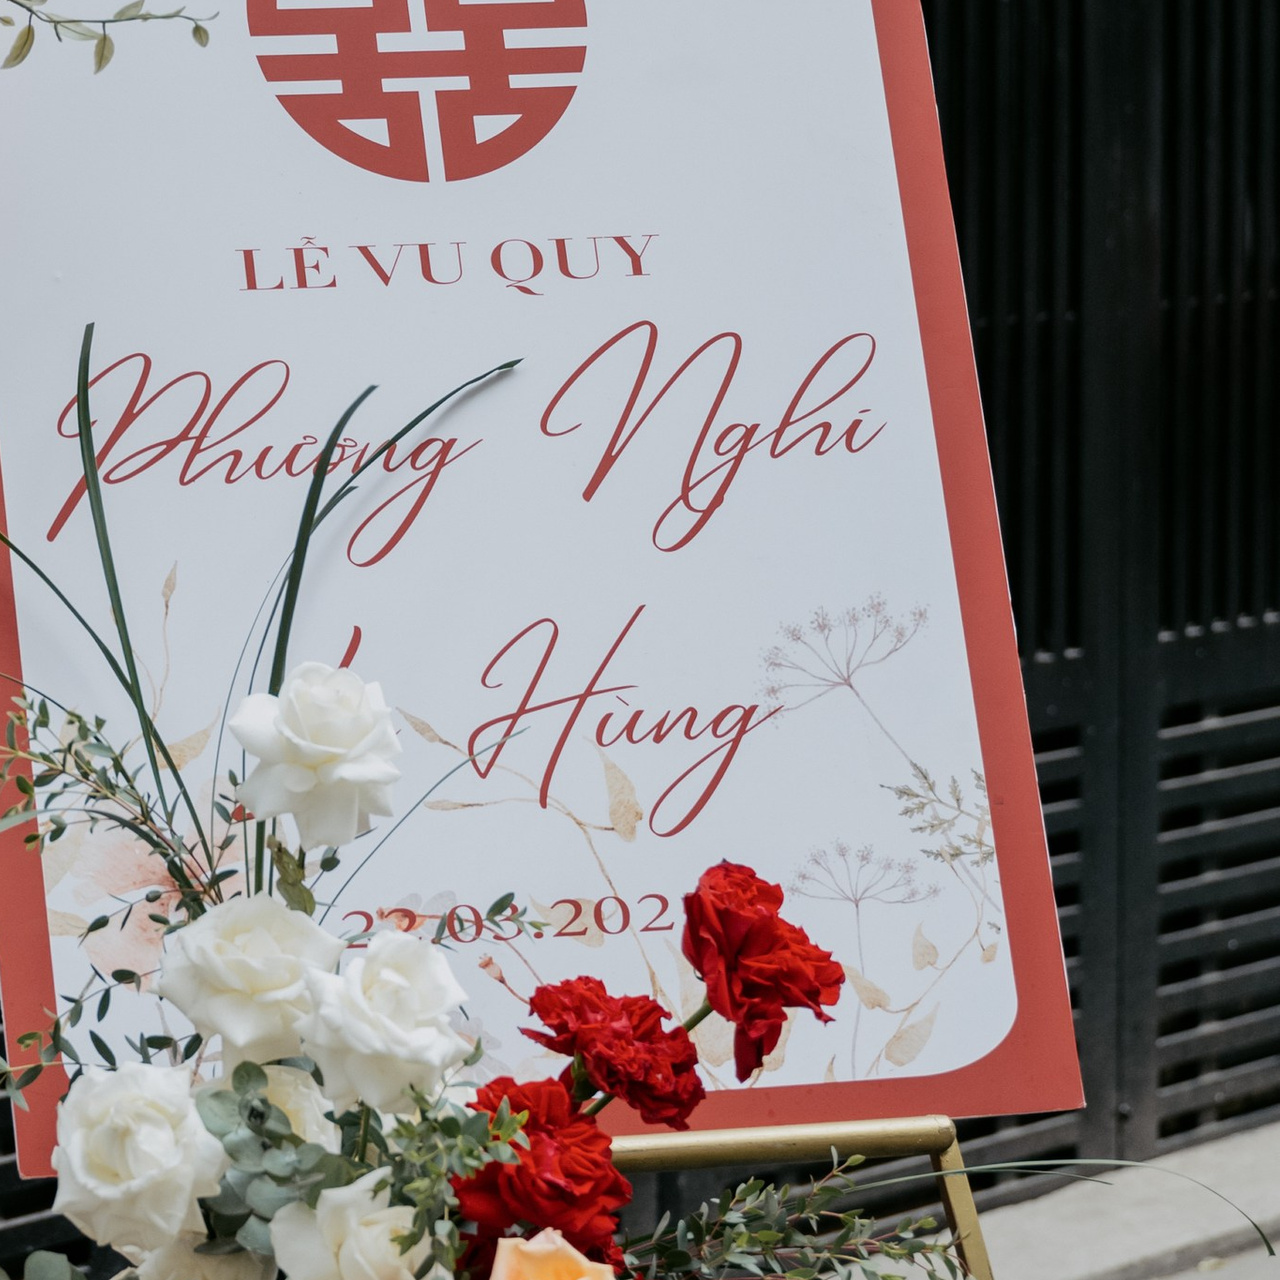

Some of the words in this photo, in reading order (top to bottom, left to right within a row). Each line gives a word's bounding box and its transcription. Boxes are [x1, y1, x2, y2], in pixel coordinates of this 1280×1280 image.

[234, 235, 338, 291] LỄ
[348, 241, 468, 288] VU
[489, 234, 661, 297] QUY
[467, 604, 784, 838] Hùng
[340, 892, 677, 951] 22.03.202
